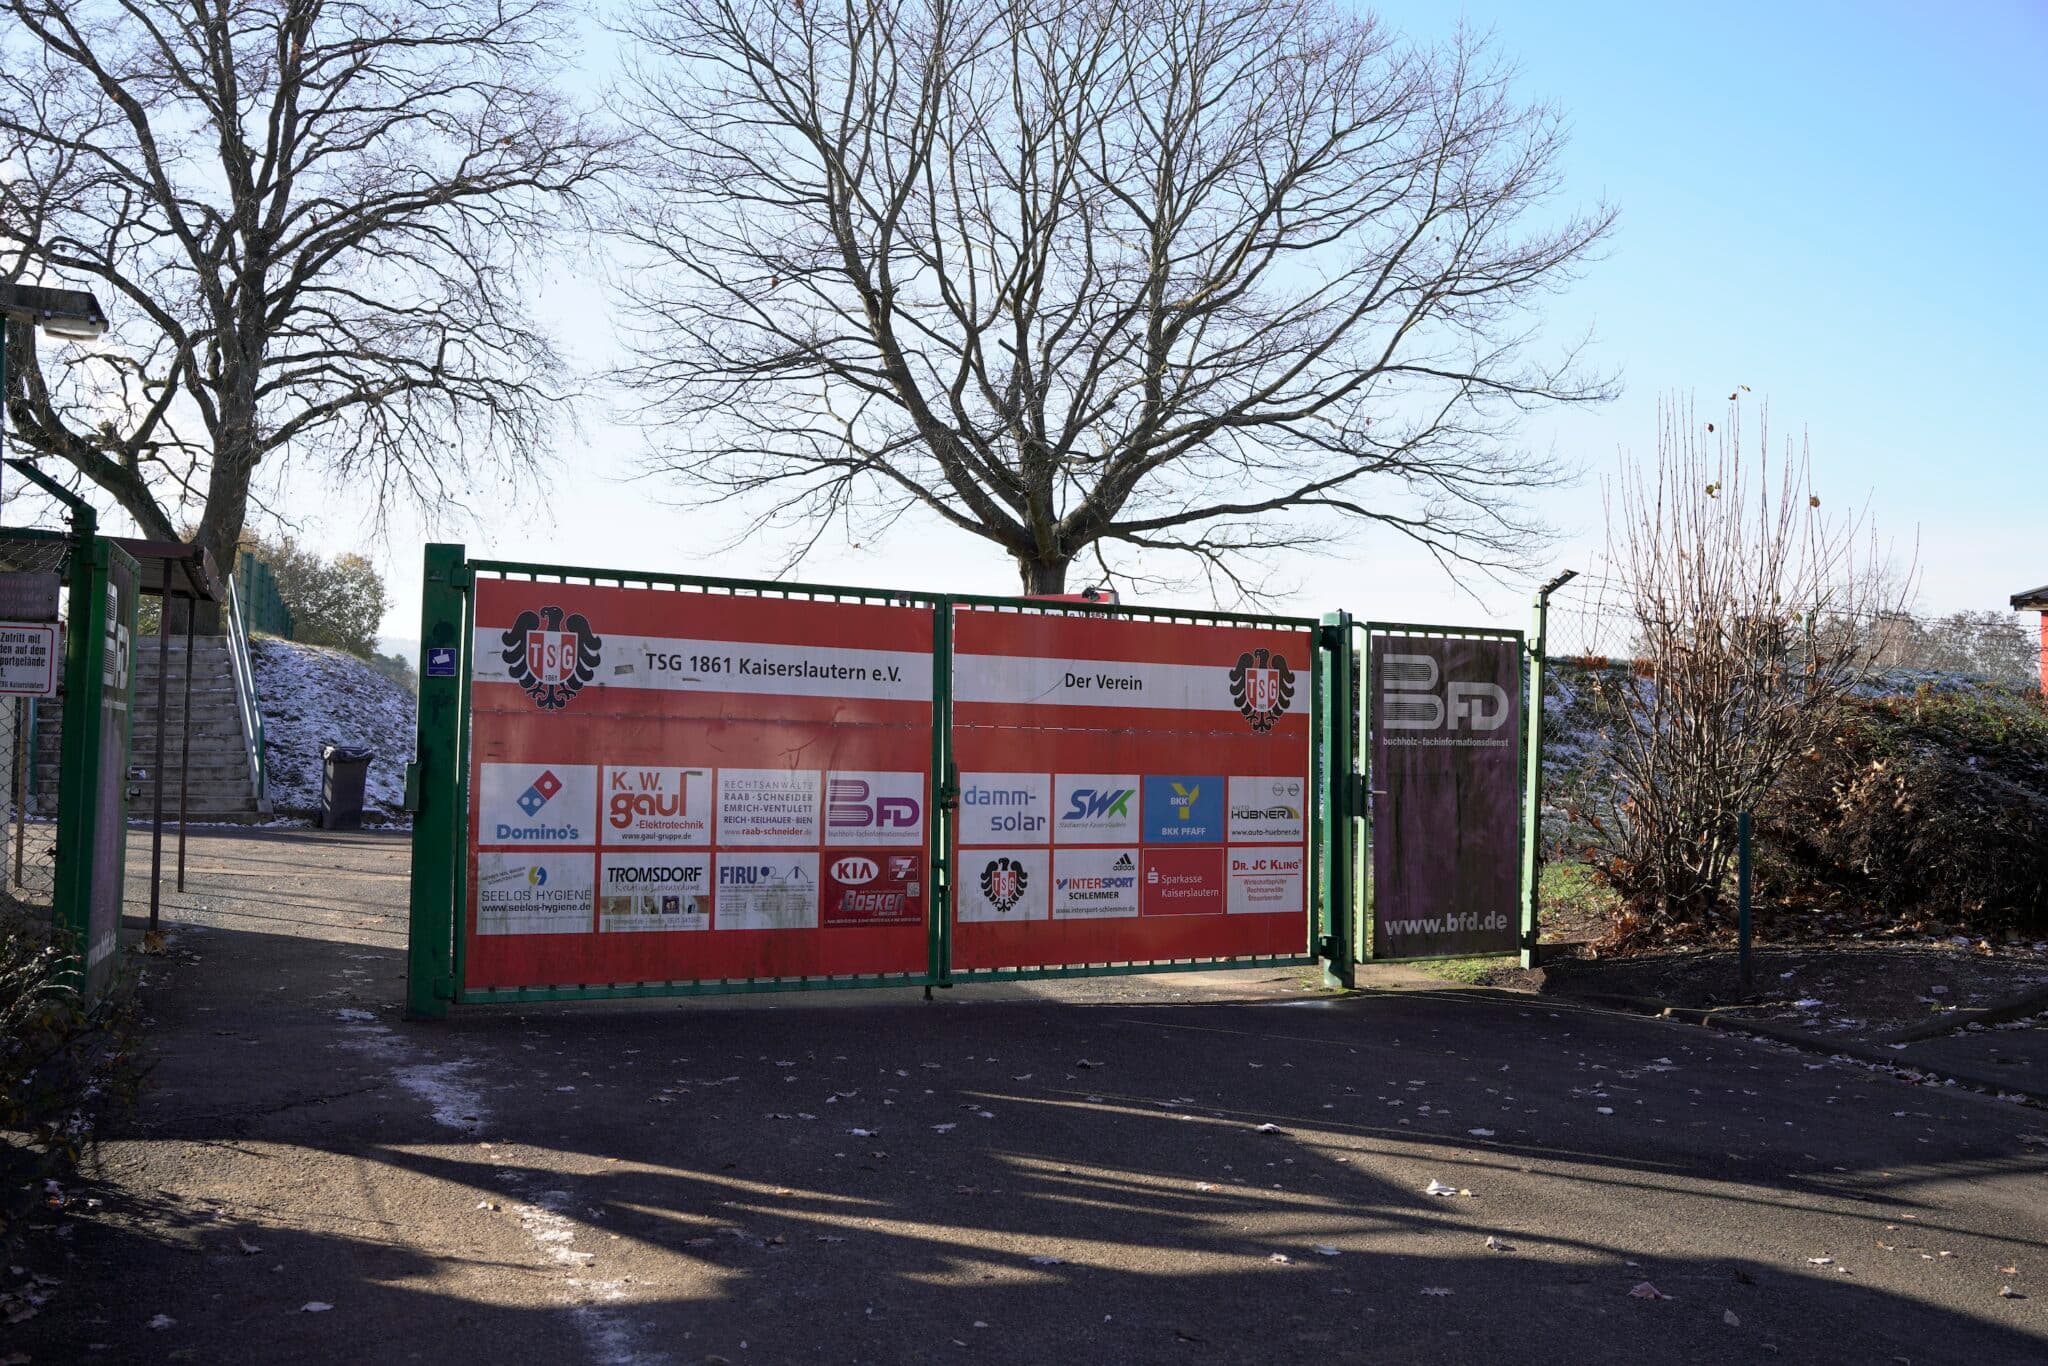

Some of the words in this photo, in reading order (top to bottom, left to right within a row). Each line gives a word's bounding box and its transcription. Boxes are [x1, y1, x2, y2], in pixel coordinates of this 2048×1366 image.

[1, 632, 25, 643] Zutritt
[28, 634, 41, 644] mit
[15, 645, 28, 655] auf
[30, 645, 46, 655] dem
[646, 653, 682, 671] TSG
[690, 656, 731, 674] 1861
[739, 658, 866, 681] Kaiserslautern
[872, 666, 902, 682] e.V.
[1065, 673, 1092, 688] Der
[1096, 675, 1143, 690] Verein
[1383, 653, 1509, 731] BFD
[612, 772, 633, 791] K.
[639, 772, 663, 791] W.
[610, 771, 687, 829] gaul
[724, 793, 749, 801] RAAB
[757, 793, 813, 802] SCHNEIDER
[964, 785, 1036, 805] damm-
[1170, 797, 1188, 805] BKK
[829, 779, 920, 828] BFD
[1062, 789, 1136, 820] SWK
[723, 816, 747, 824] REICH
[991, 811, 1046, 831] solar
[496, 824, 579, 840] Domino's
[622, 832, 692, 841] www.gaul-gruppe.de
[1161, 827, 1179, 836] BKK
[1181, 827, 1206, 836] PFAFF
[837, 862, 873, 879] KIA
[895, 859, 912, 879] 7
[1252, 860, 1267, 870] JC
[608, 867, 702, 882] TROMSDORF
[720, 866, 758, 884] FIRU
[1161, 874, 1202, 885] Sparkasse
[1068, 877, 1134, 890] INTERSPORT
[481, 890, 532, 902] SEELOS
[536, 890, 592, 901] HYGIENE
[1068, 892, 1119, 900] SCHLEMMER
[1161, 888, 1219, 898] Kaiserslautern
[481, 903, 591, 913] www.seelos-hygiene.de
[1384, 911, 1508, 936] www.bfd.de
